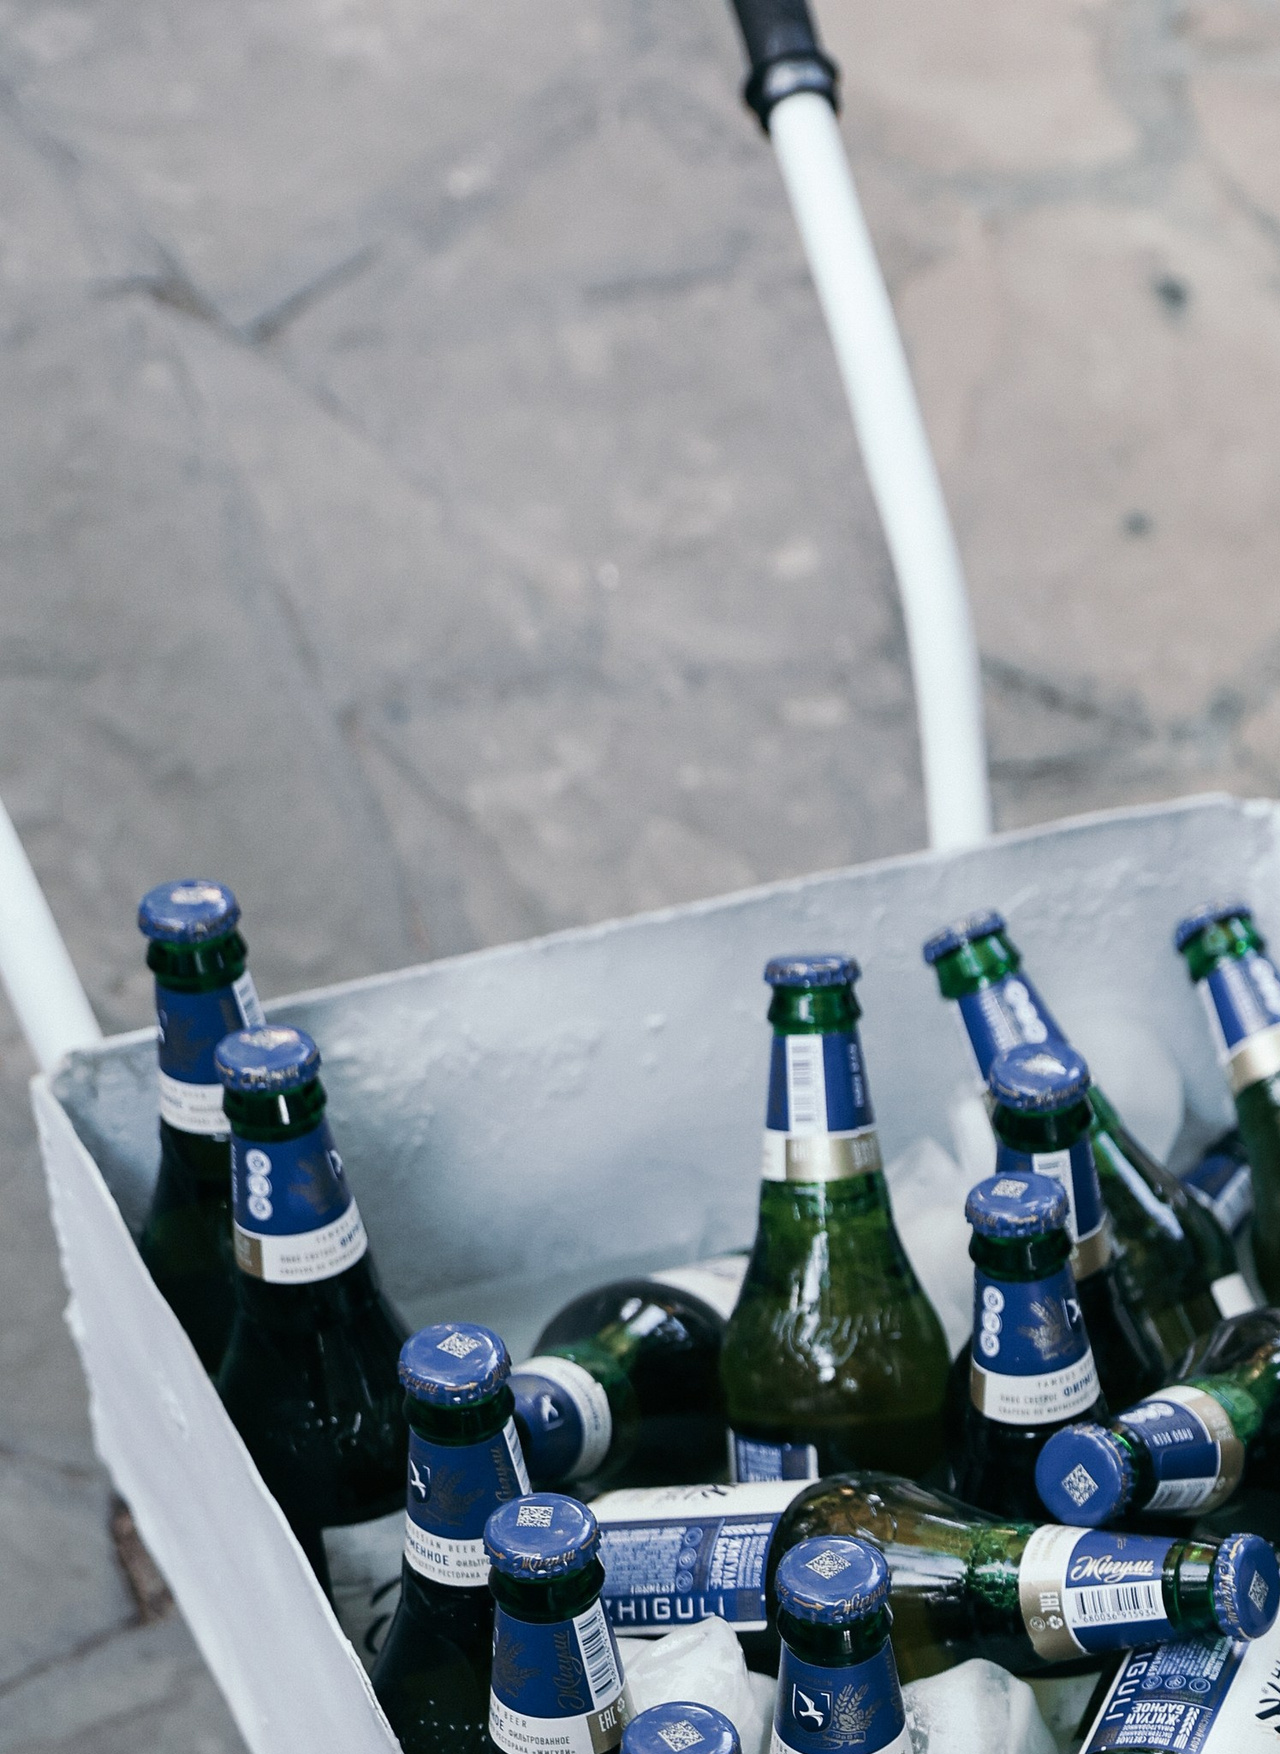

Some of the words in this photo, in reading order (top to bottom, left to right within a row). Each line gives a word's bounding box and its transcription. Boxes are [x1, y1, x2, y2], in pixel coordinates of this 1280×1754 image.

[1070, 1554, 1154, 1583] Жигули
[1105, 1652, 1153, 1721] IGULI
[508, 1729, 570, 1745] ФИЛЬТРОВАННОЕ
